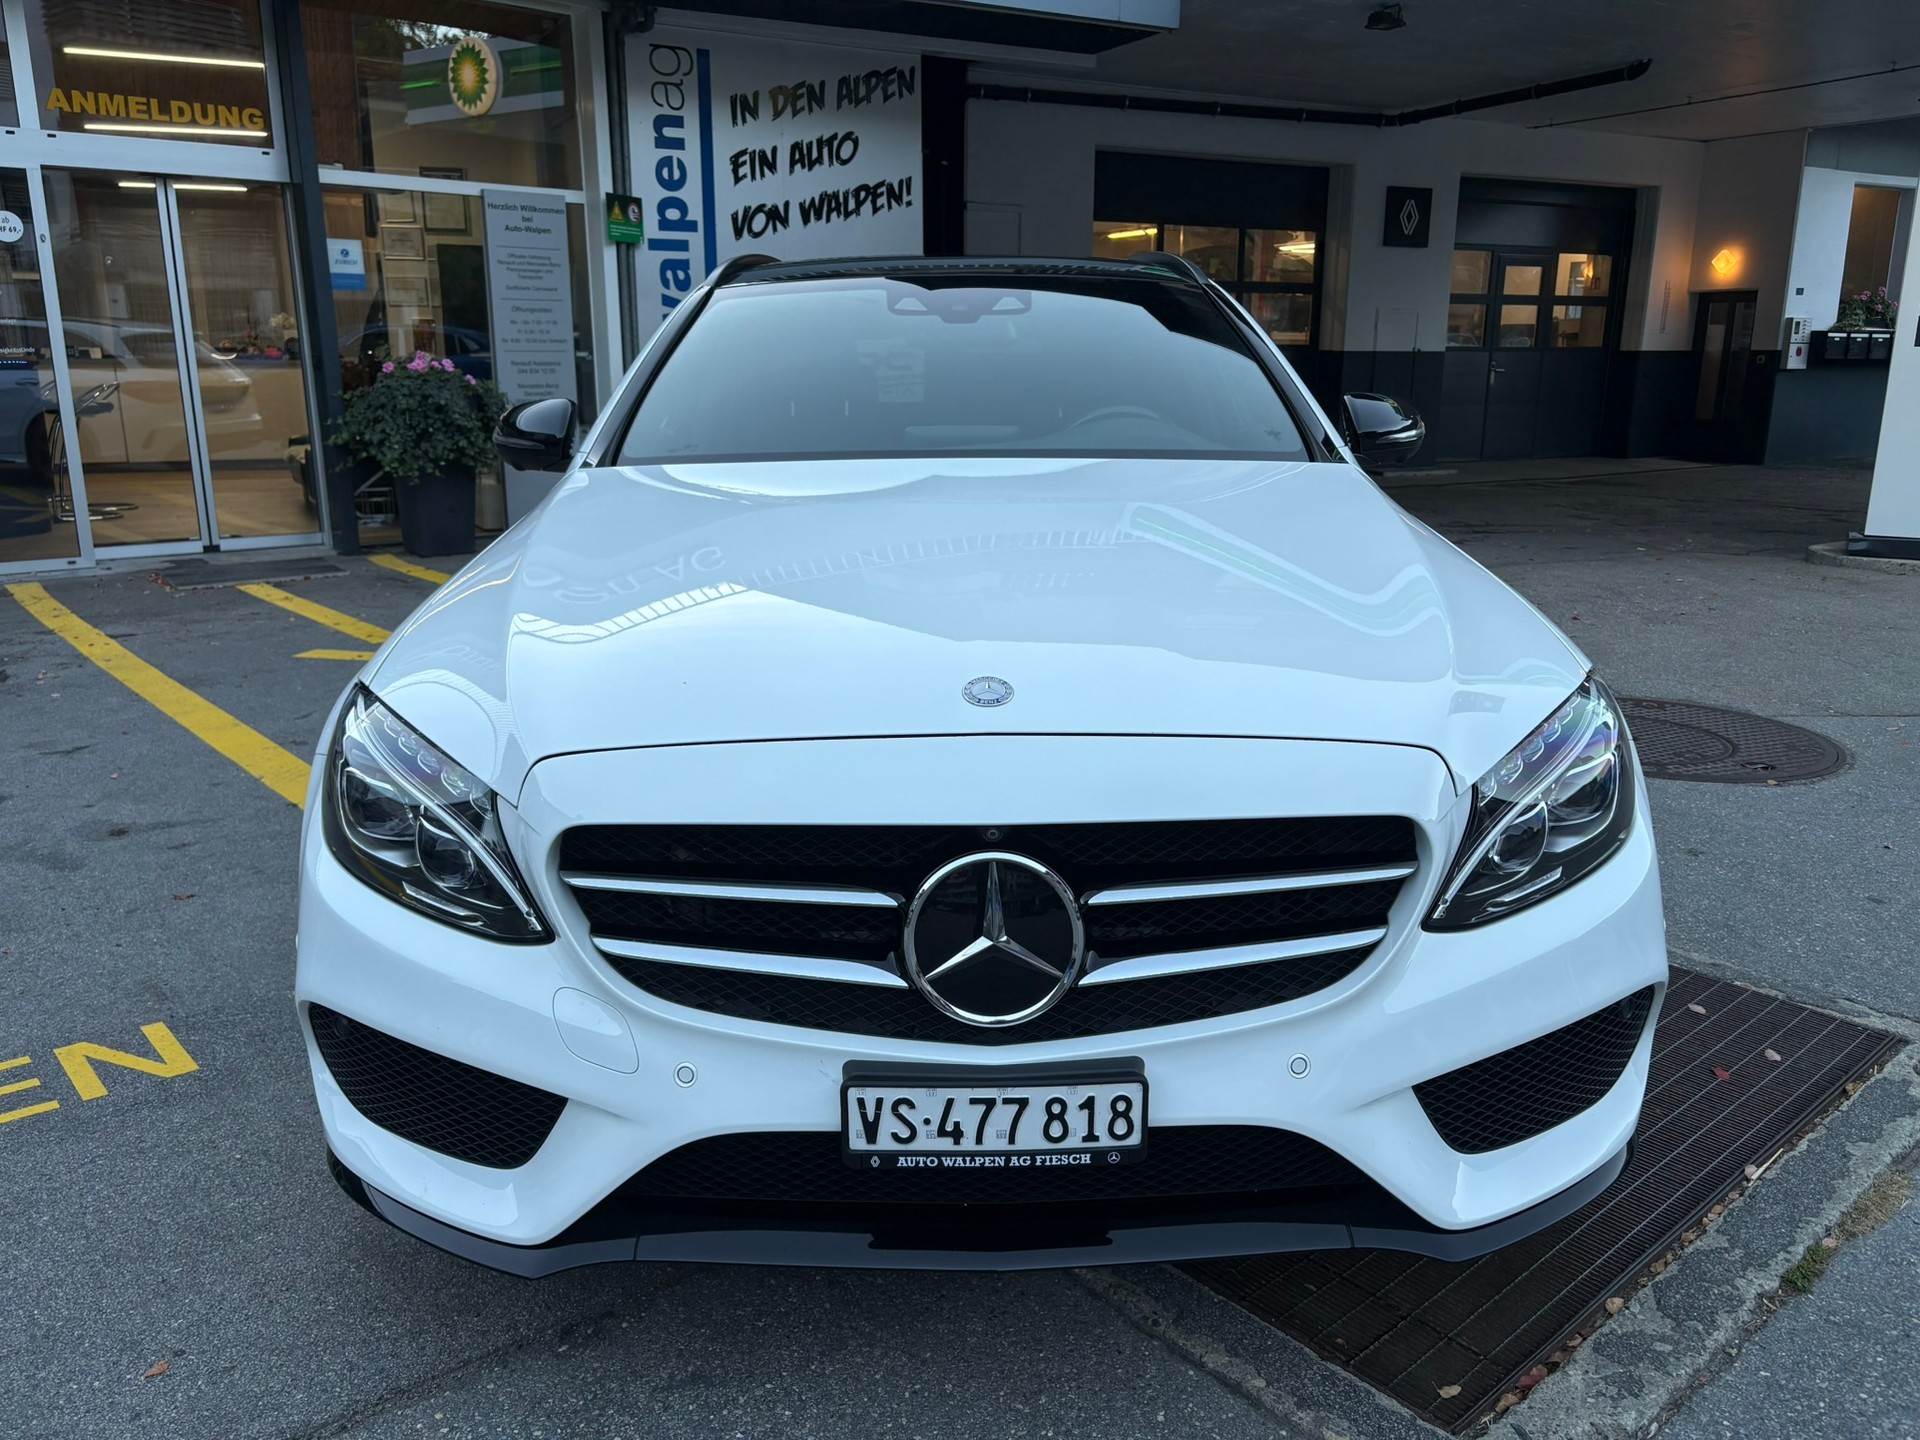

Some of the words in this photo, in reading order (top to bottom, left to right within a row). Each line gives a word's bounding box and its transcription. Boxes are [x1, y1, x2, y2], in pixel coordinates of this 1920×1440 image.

[46, 87, 265, 131] ANMELDUNG
[730, 90, 759, 128] IN
[769, 80, 825, 121] DEN
[836, 66, 915, 111] ALPEN
[730, 145, 777, 186] EIN
[789, 131, 859, 176] AUTO
[487, 202, 519, 212] Herzlich
[520, 204, 565, 215] Willkommen
[504, 224, 552, 235] Auto-Walpen
[522, 215, 533, 223] bei
[731, 200, 789, 241] VON
[800, 176, 912, 228] WALPEN!
[1043, 1094, 1135, 1144] 818
[897, 1156, 938, 1167] AUTO
[941, 1156, 1005, 1167] WALPEN
[1009, 1156, 1031, 1167] AG
[1035, 1153, 1091, 1166] FIESCH
